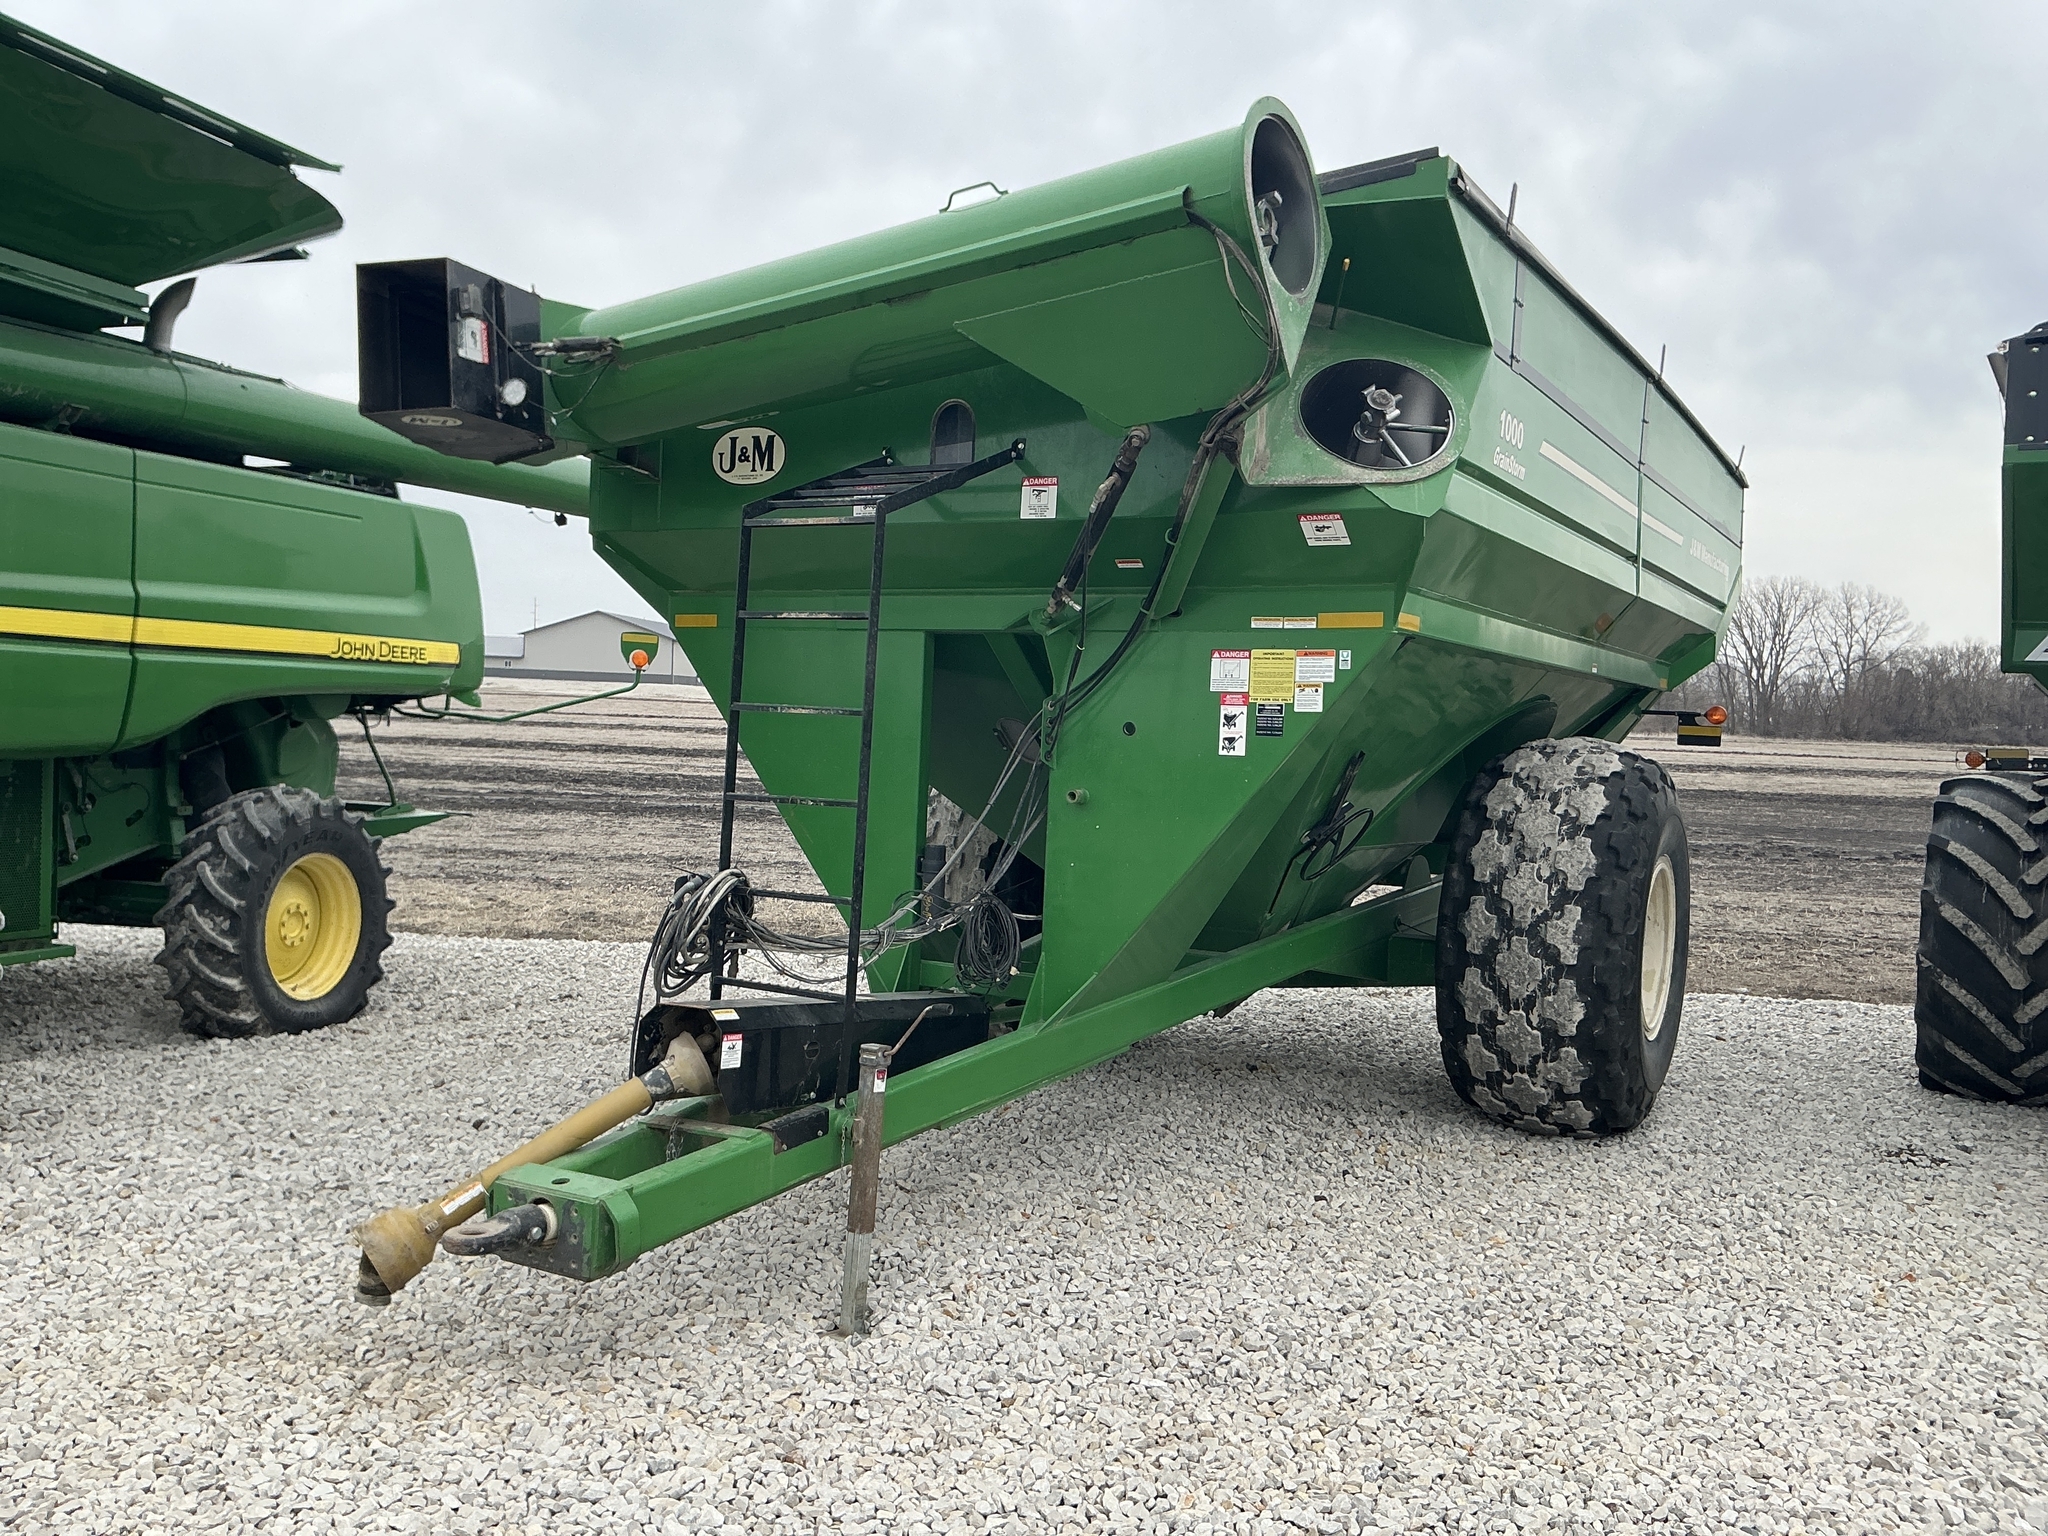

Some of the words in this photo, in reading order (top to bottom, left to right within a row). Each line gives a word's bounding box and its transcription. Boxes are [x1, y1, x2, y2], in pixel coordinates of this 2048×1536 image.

[1500, 409, 1524, 450] 1000
[718, 434, 776, 474] J&M
[1493, 446, 1526, 481] GrainStorm
[1029, 477, 1058, 485] DANGER
[331, 637, 375, 657] JOHN
[379, 640, 427, 661] DEERE
